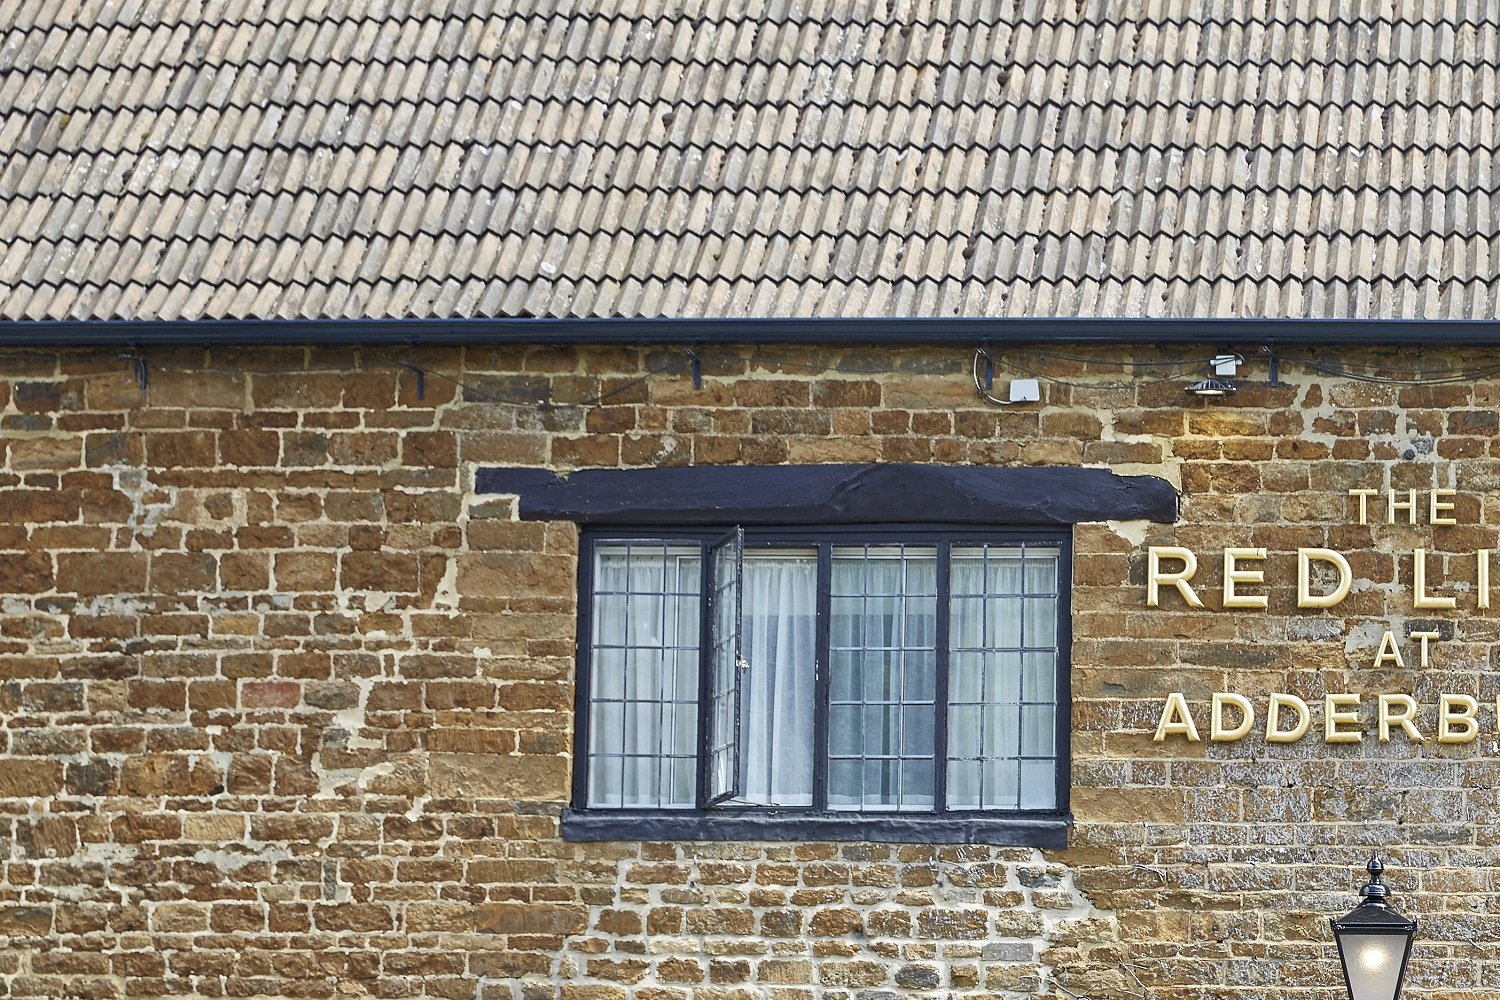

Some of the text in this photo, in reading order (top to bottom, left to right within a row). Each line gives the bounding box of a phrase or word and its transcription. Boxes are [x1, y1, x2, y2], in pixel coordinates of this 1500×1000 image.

[1349, 488, 1457, 525] THE
[1147, 546, 1353, 609] RED
[1373, 630, 1439, 668] AT
